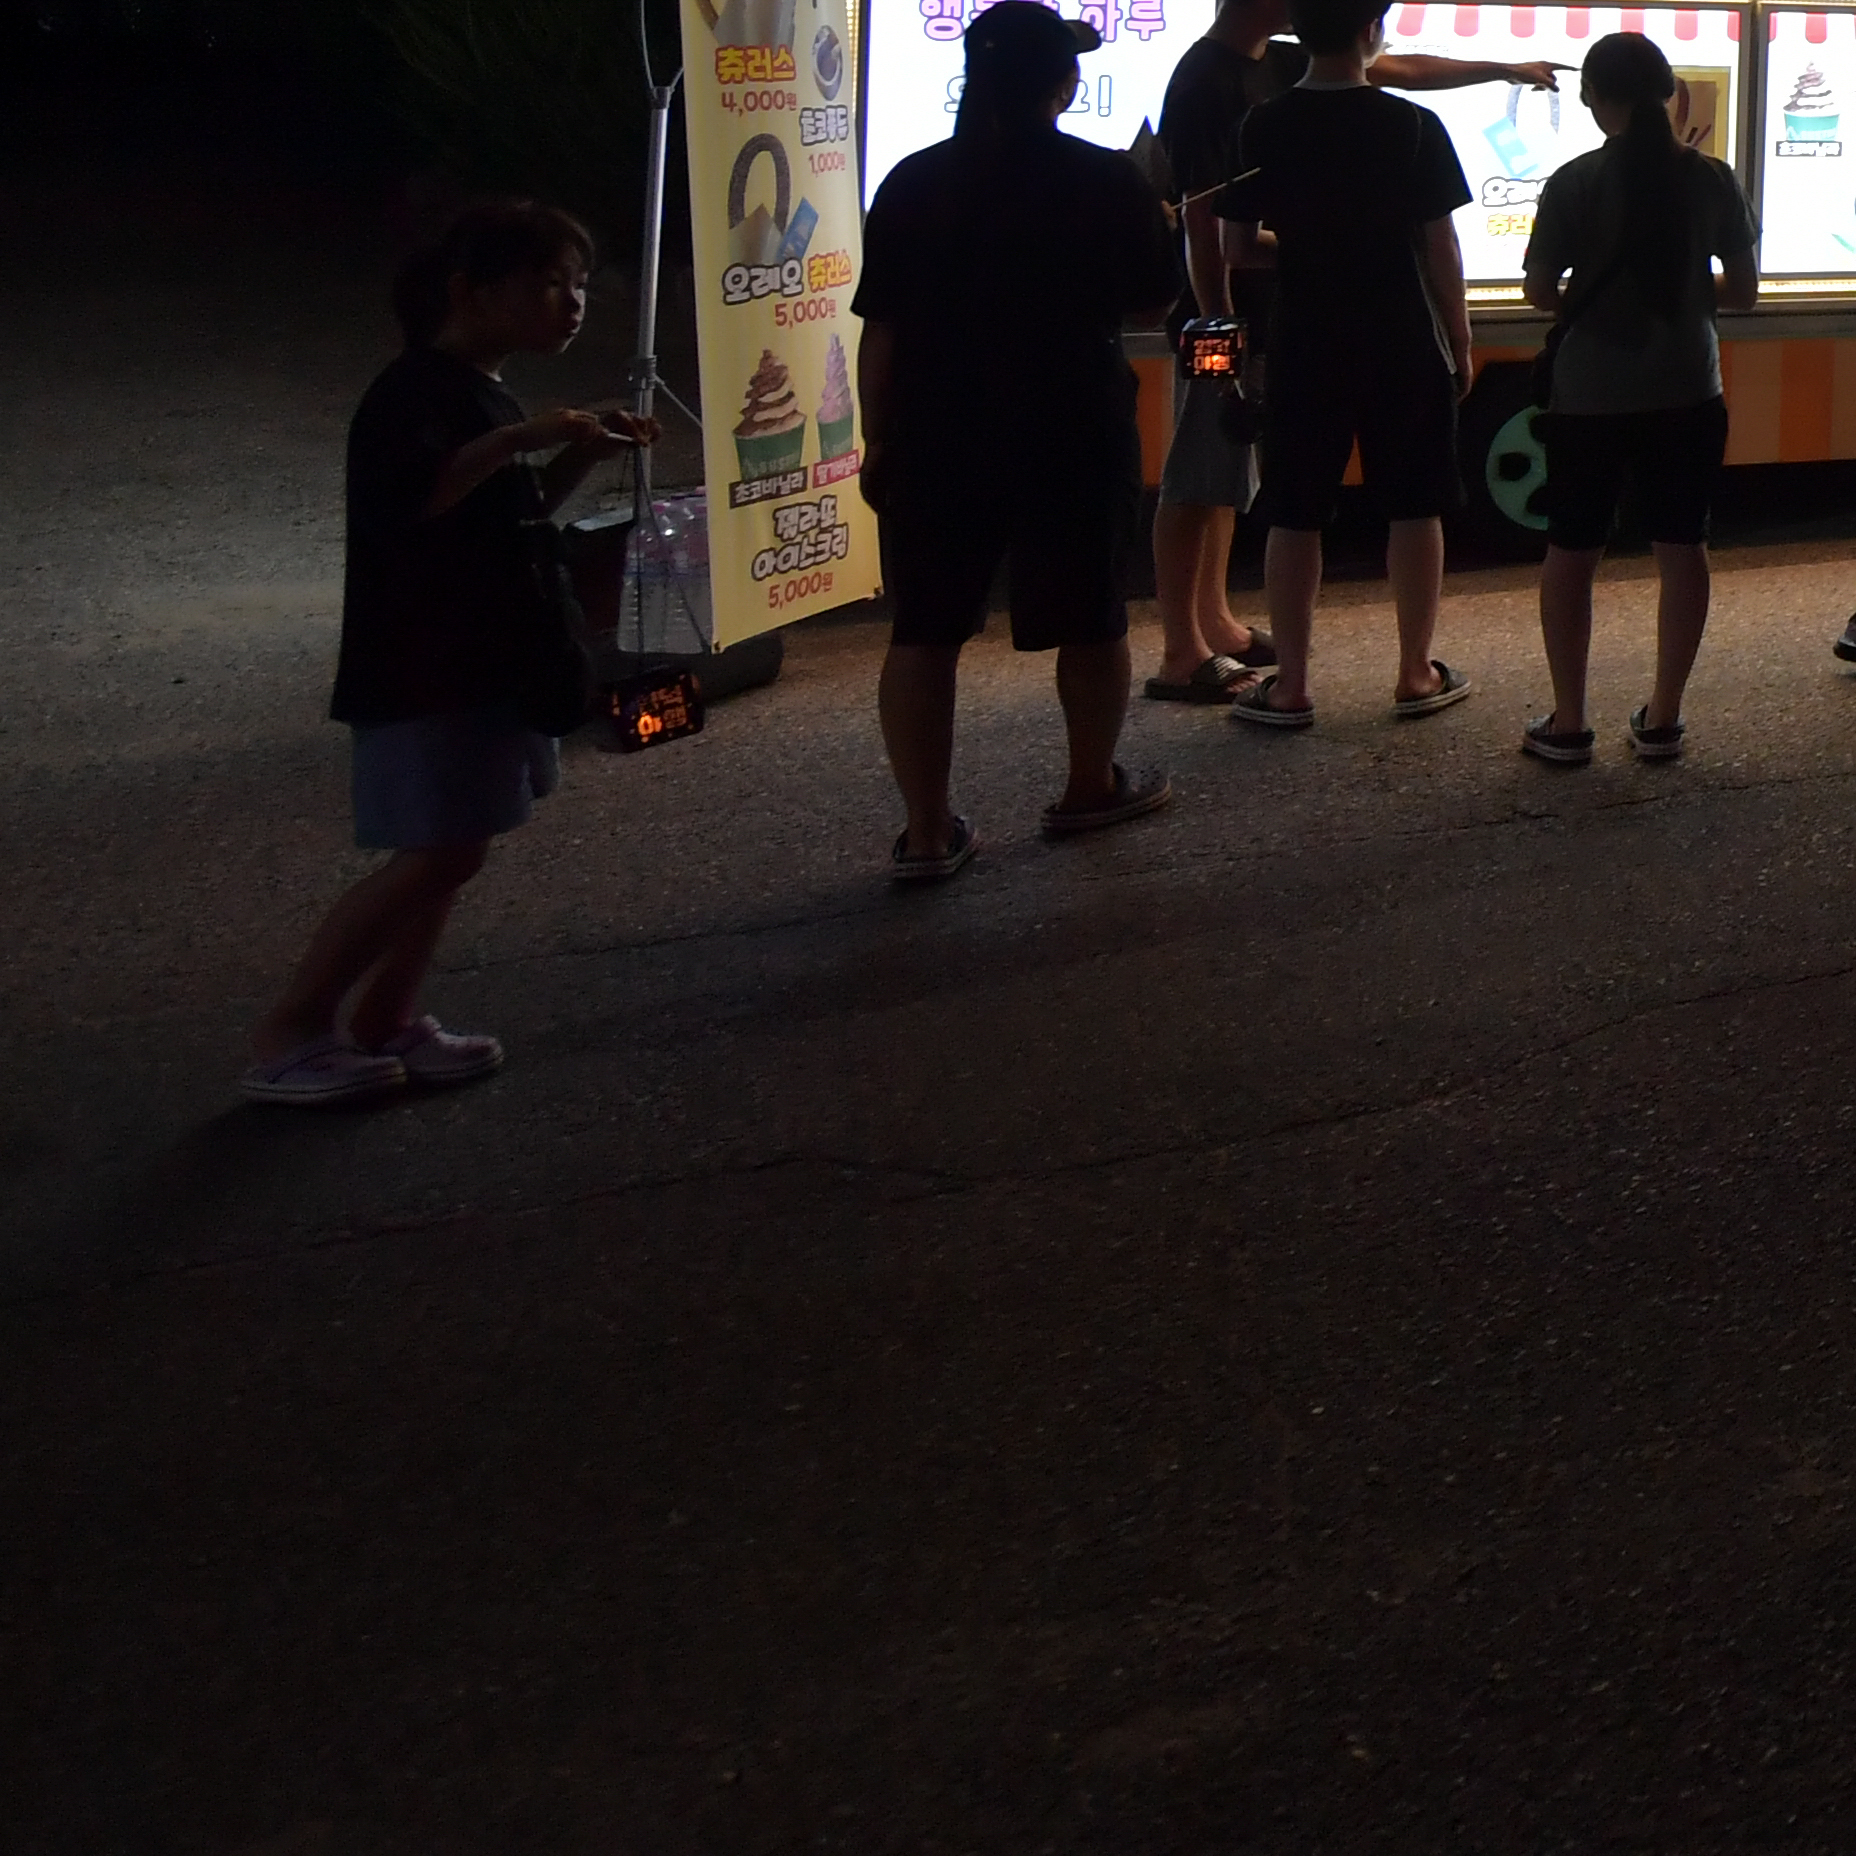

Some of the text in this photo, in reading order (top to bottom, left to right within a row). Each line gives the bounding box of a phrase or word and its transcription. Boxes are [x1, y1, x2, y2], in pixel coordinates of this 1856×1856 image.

[716, 44, 797, 84] 츄러스
[721, 90, 798, 116] 4,000원
[1481, 175, 1548, 208] 오레
[1486, 212, 1533, 237] 츄러
[721, 248, 853, 306] 오레오 츄러스
[773, 297, 837, 329] 5,000원
[734, 470, 804, 504] 초코바닐라
[772, 493, 838, 542] 젤라또
[750, 522, 850, 582] 아이스크림
[768, 571, 834, 610] 5,000원
